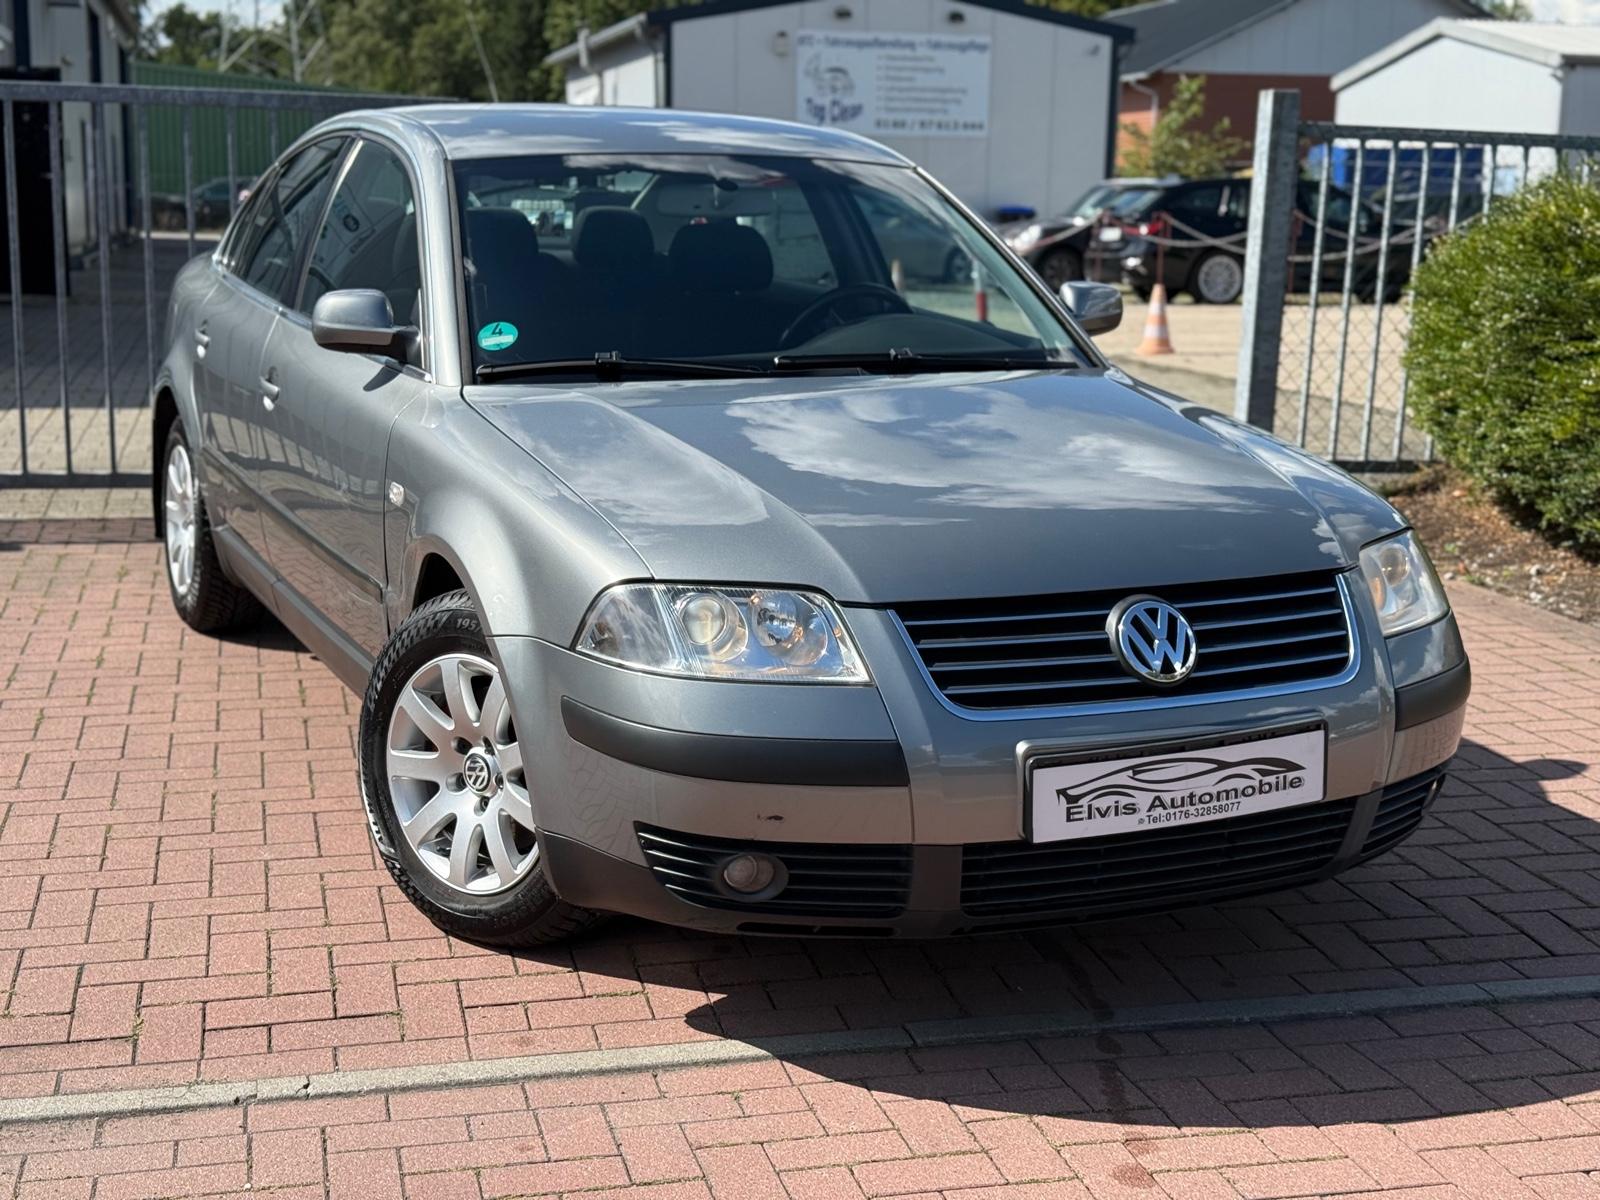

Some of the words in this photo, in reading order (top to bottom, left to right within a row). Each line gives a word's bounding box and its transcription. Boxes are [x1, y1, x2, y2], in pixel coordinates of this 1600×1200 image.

[491, 323, 503, 336] 4
[1065, 800, 1138, 823] Elvis
[1147, 774, 1304, 813] Automobile
